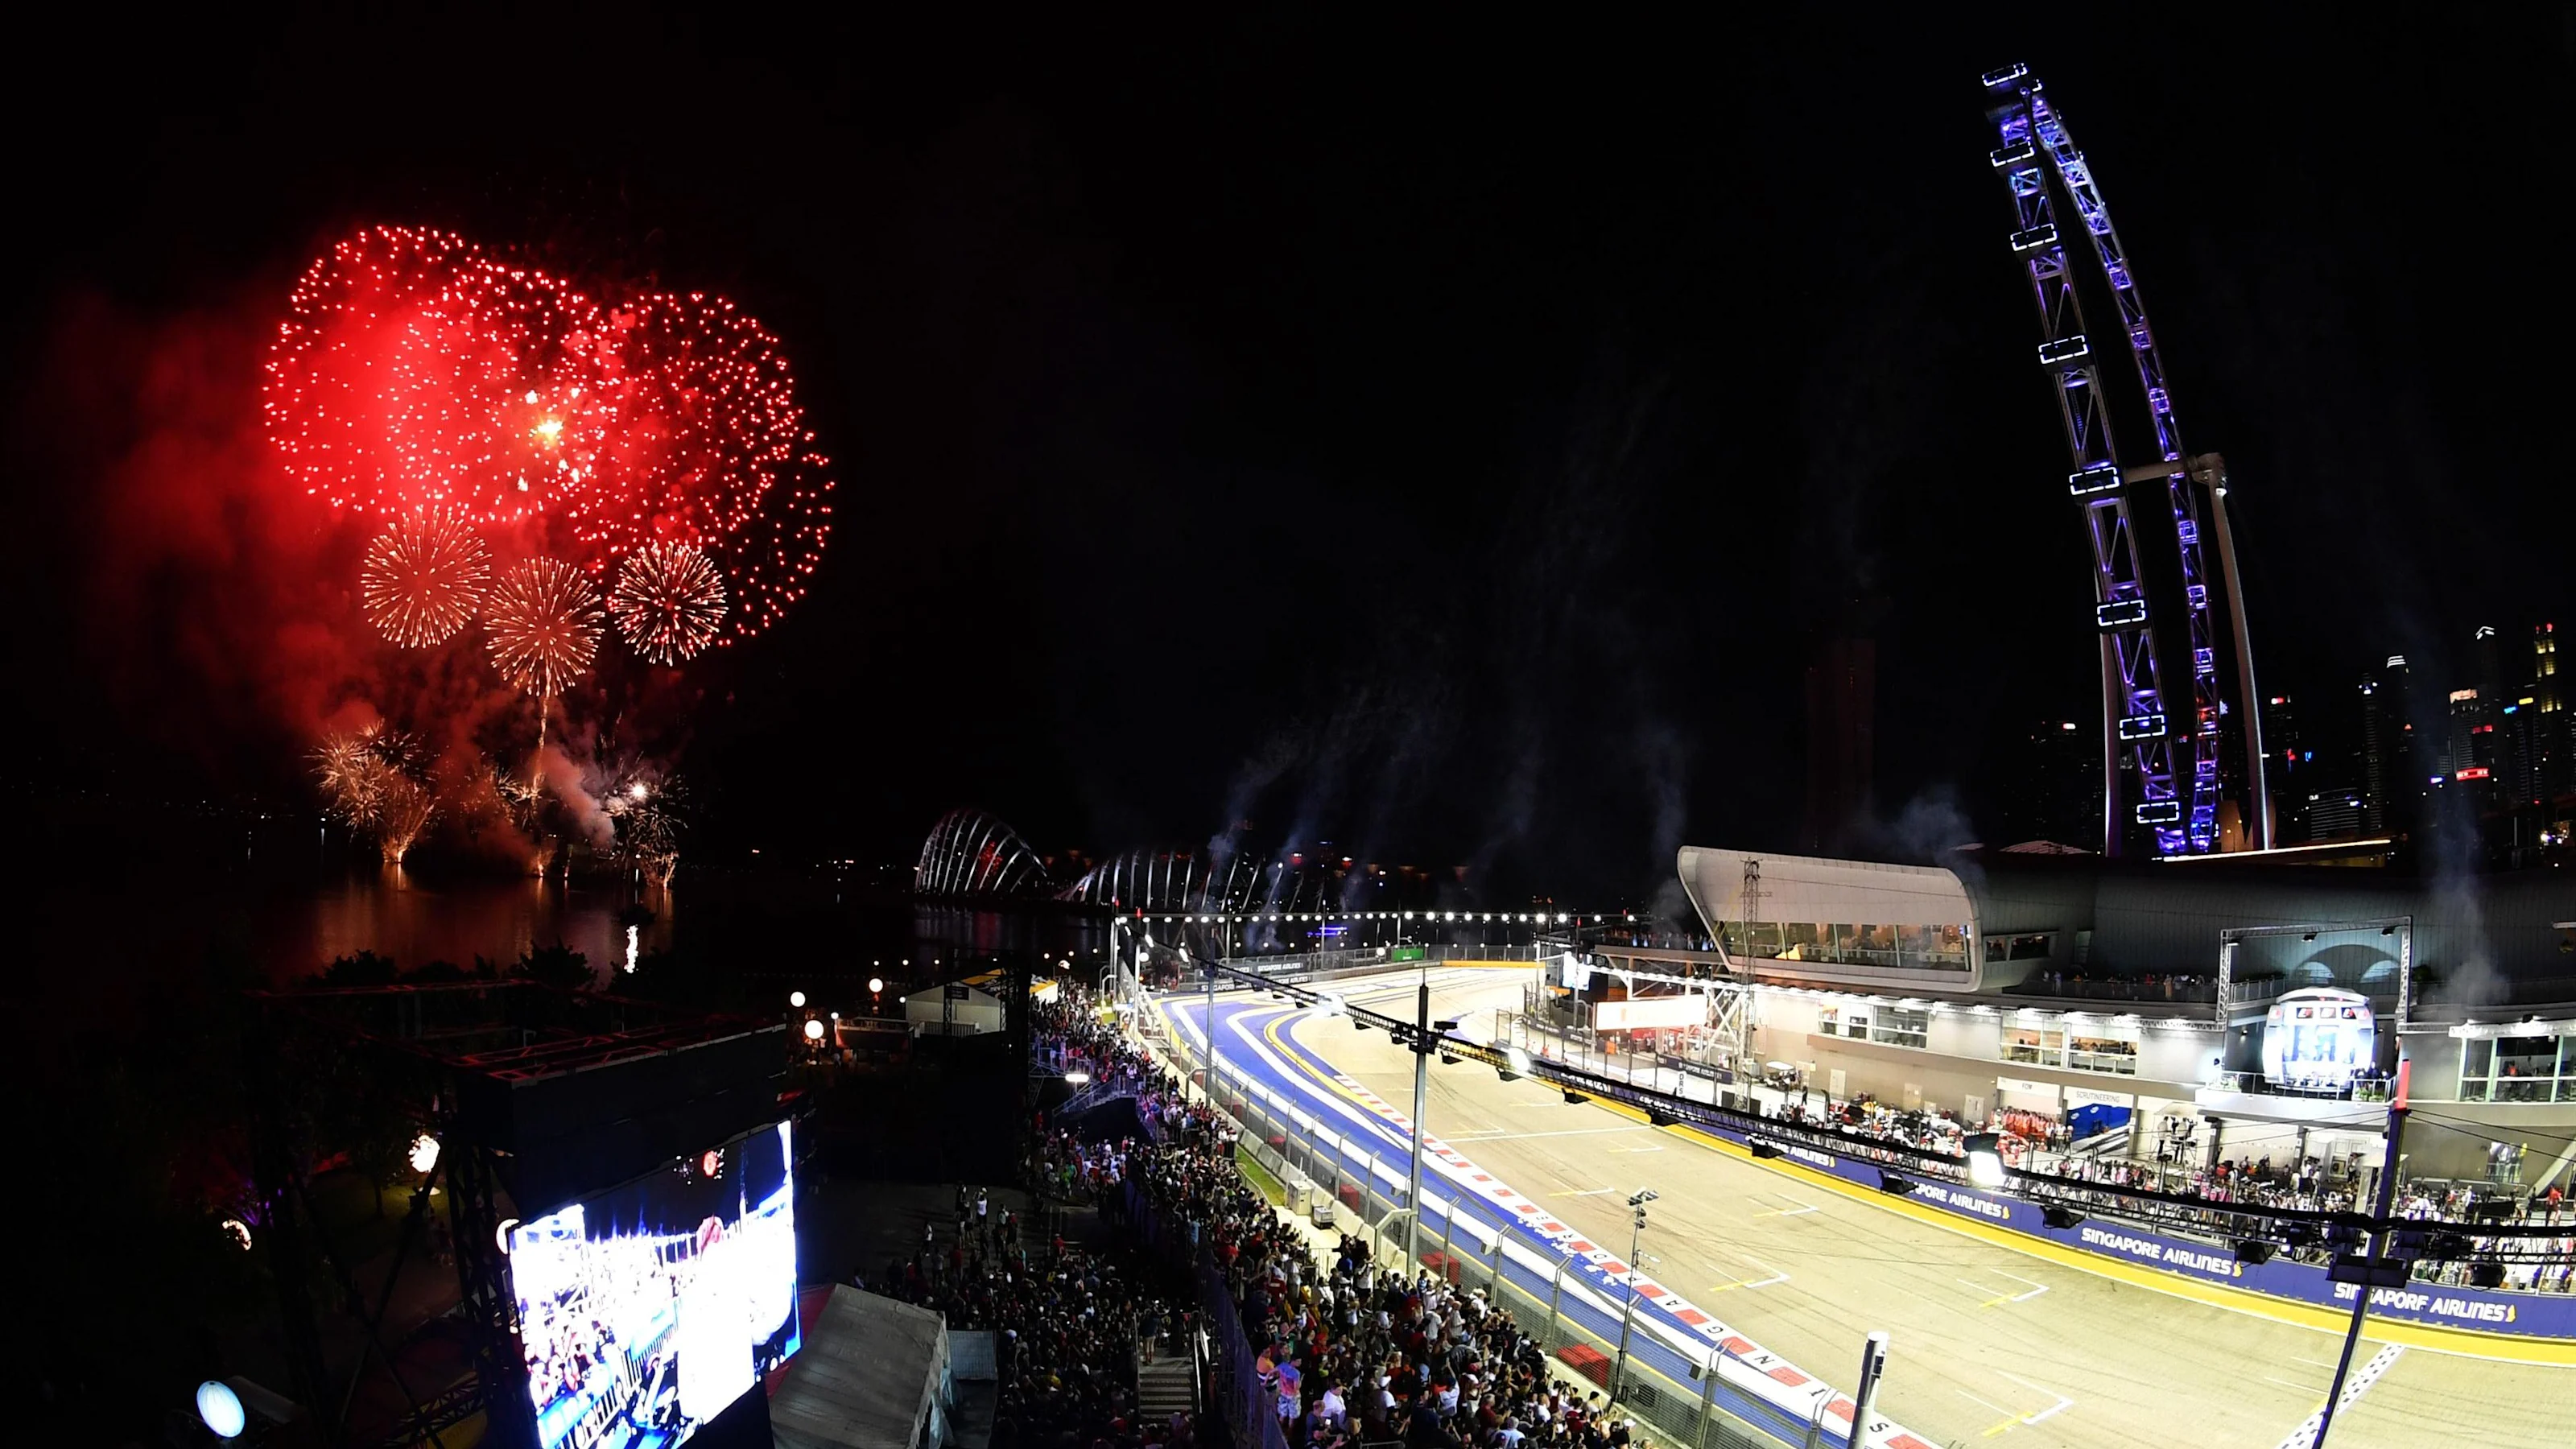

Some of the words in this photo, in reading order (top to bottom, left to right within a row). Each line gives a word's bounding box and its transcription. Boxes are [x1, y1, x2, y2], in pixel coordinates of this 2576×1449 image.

[2076, 1092, 2120, 1103] SCRUTINEERING
[1790, 1146, 1829, 1166] AIRLINES
[1949, 1192, 2002, 1217] AIRLINES
[2081, 1228, 2161, 1259] SINGAPORE
[2163, 1248, 2232, 1275] AIRLINES
[2430, 1298, 2505, 1321] AIRLINES
